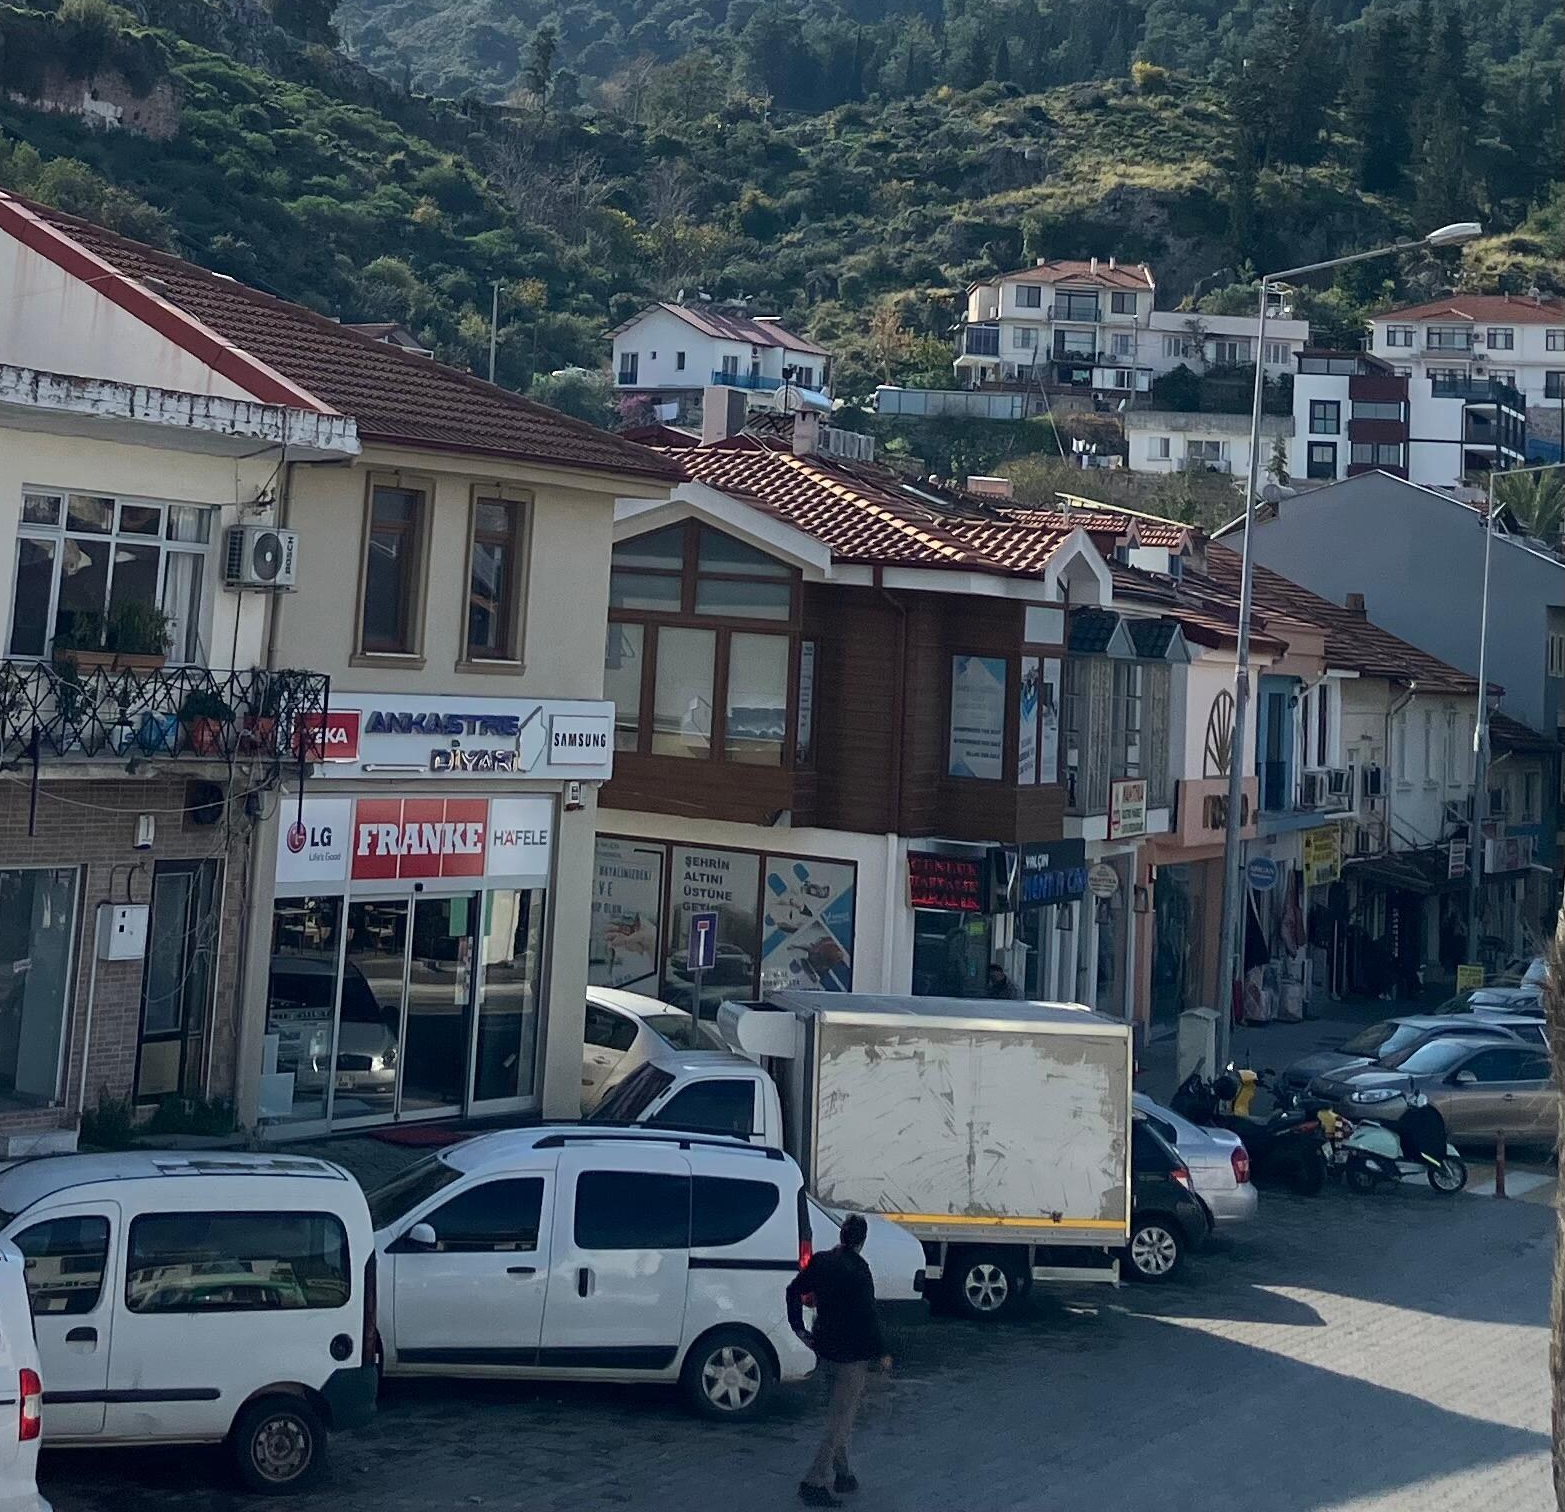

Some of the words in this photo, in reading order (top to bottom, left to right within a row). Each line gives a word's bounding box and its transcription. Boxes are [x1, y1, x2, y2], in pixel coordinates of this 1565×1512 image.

[285, 536, 294, 575] BOSCH
[553, 732, 607, 749] SAMSUNG
[310, 827, 332, 847] LG
[357, 822, 483, 856] FRANKE
[493, 829, 548, 846] HÄFELE
[685, 855, 730, 871] ŞEHRİN
[683, 871, 723, 885] ALTINI
[683, 885, 733, 902] ÜSTÜNE
